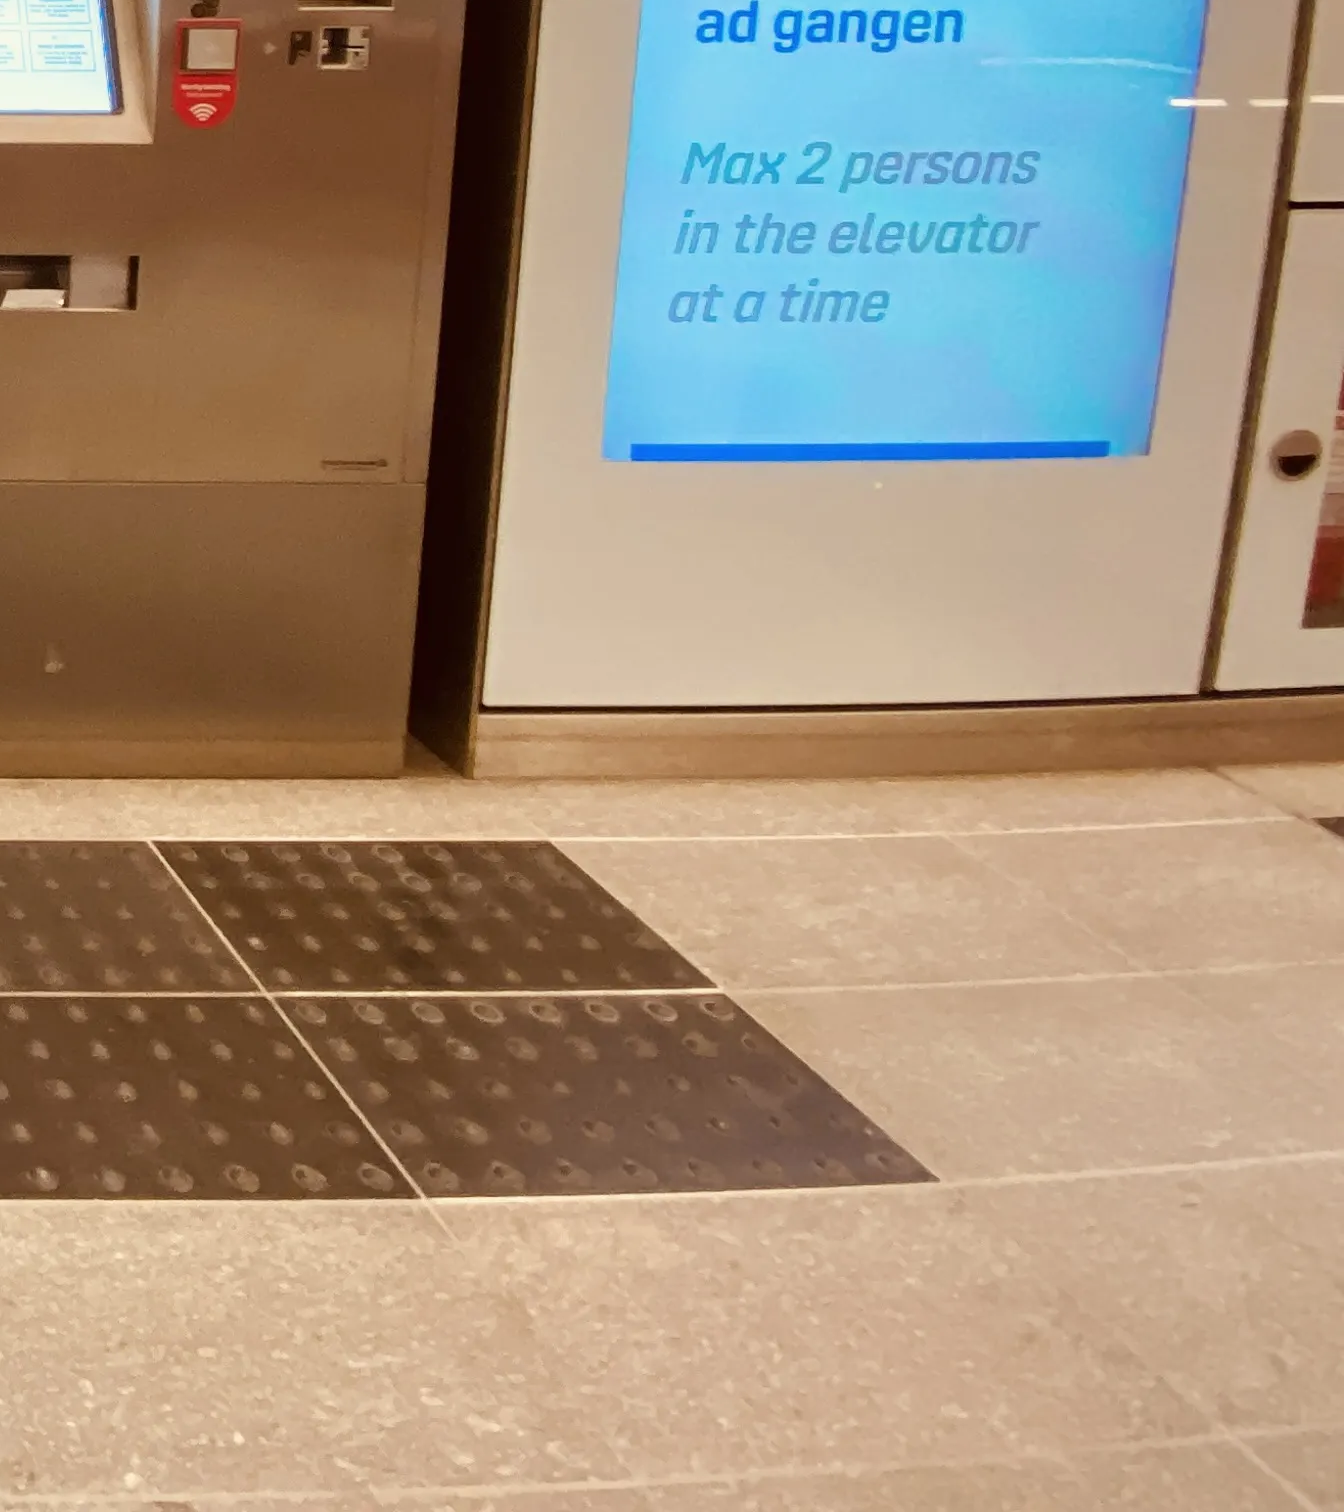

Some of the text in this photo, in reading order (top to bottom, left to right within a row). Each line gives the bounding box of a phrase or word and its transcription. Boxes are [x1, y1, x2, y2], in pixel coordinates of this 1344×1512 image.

[695, 0, 964, 54] ad gangen
[679, 141, 1041, 194] Max 2 persons
[673, 210, 1042, 255] in the elevator
[667, 280, 892, 325] at a time
